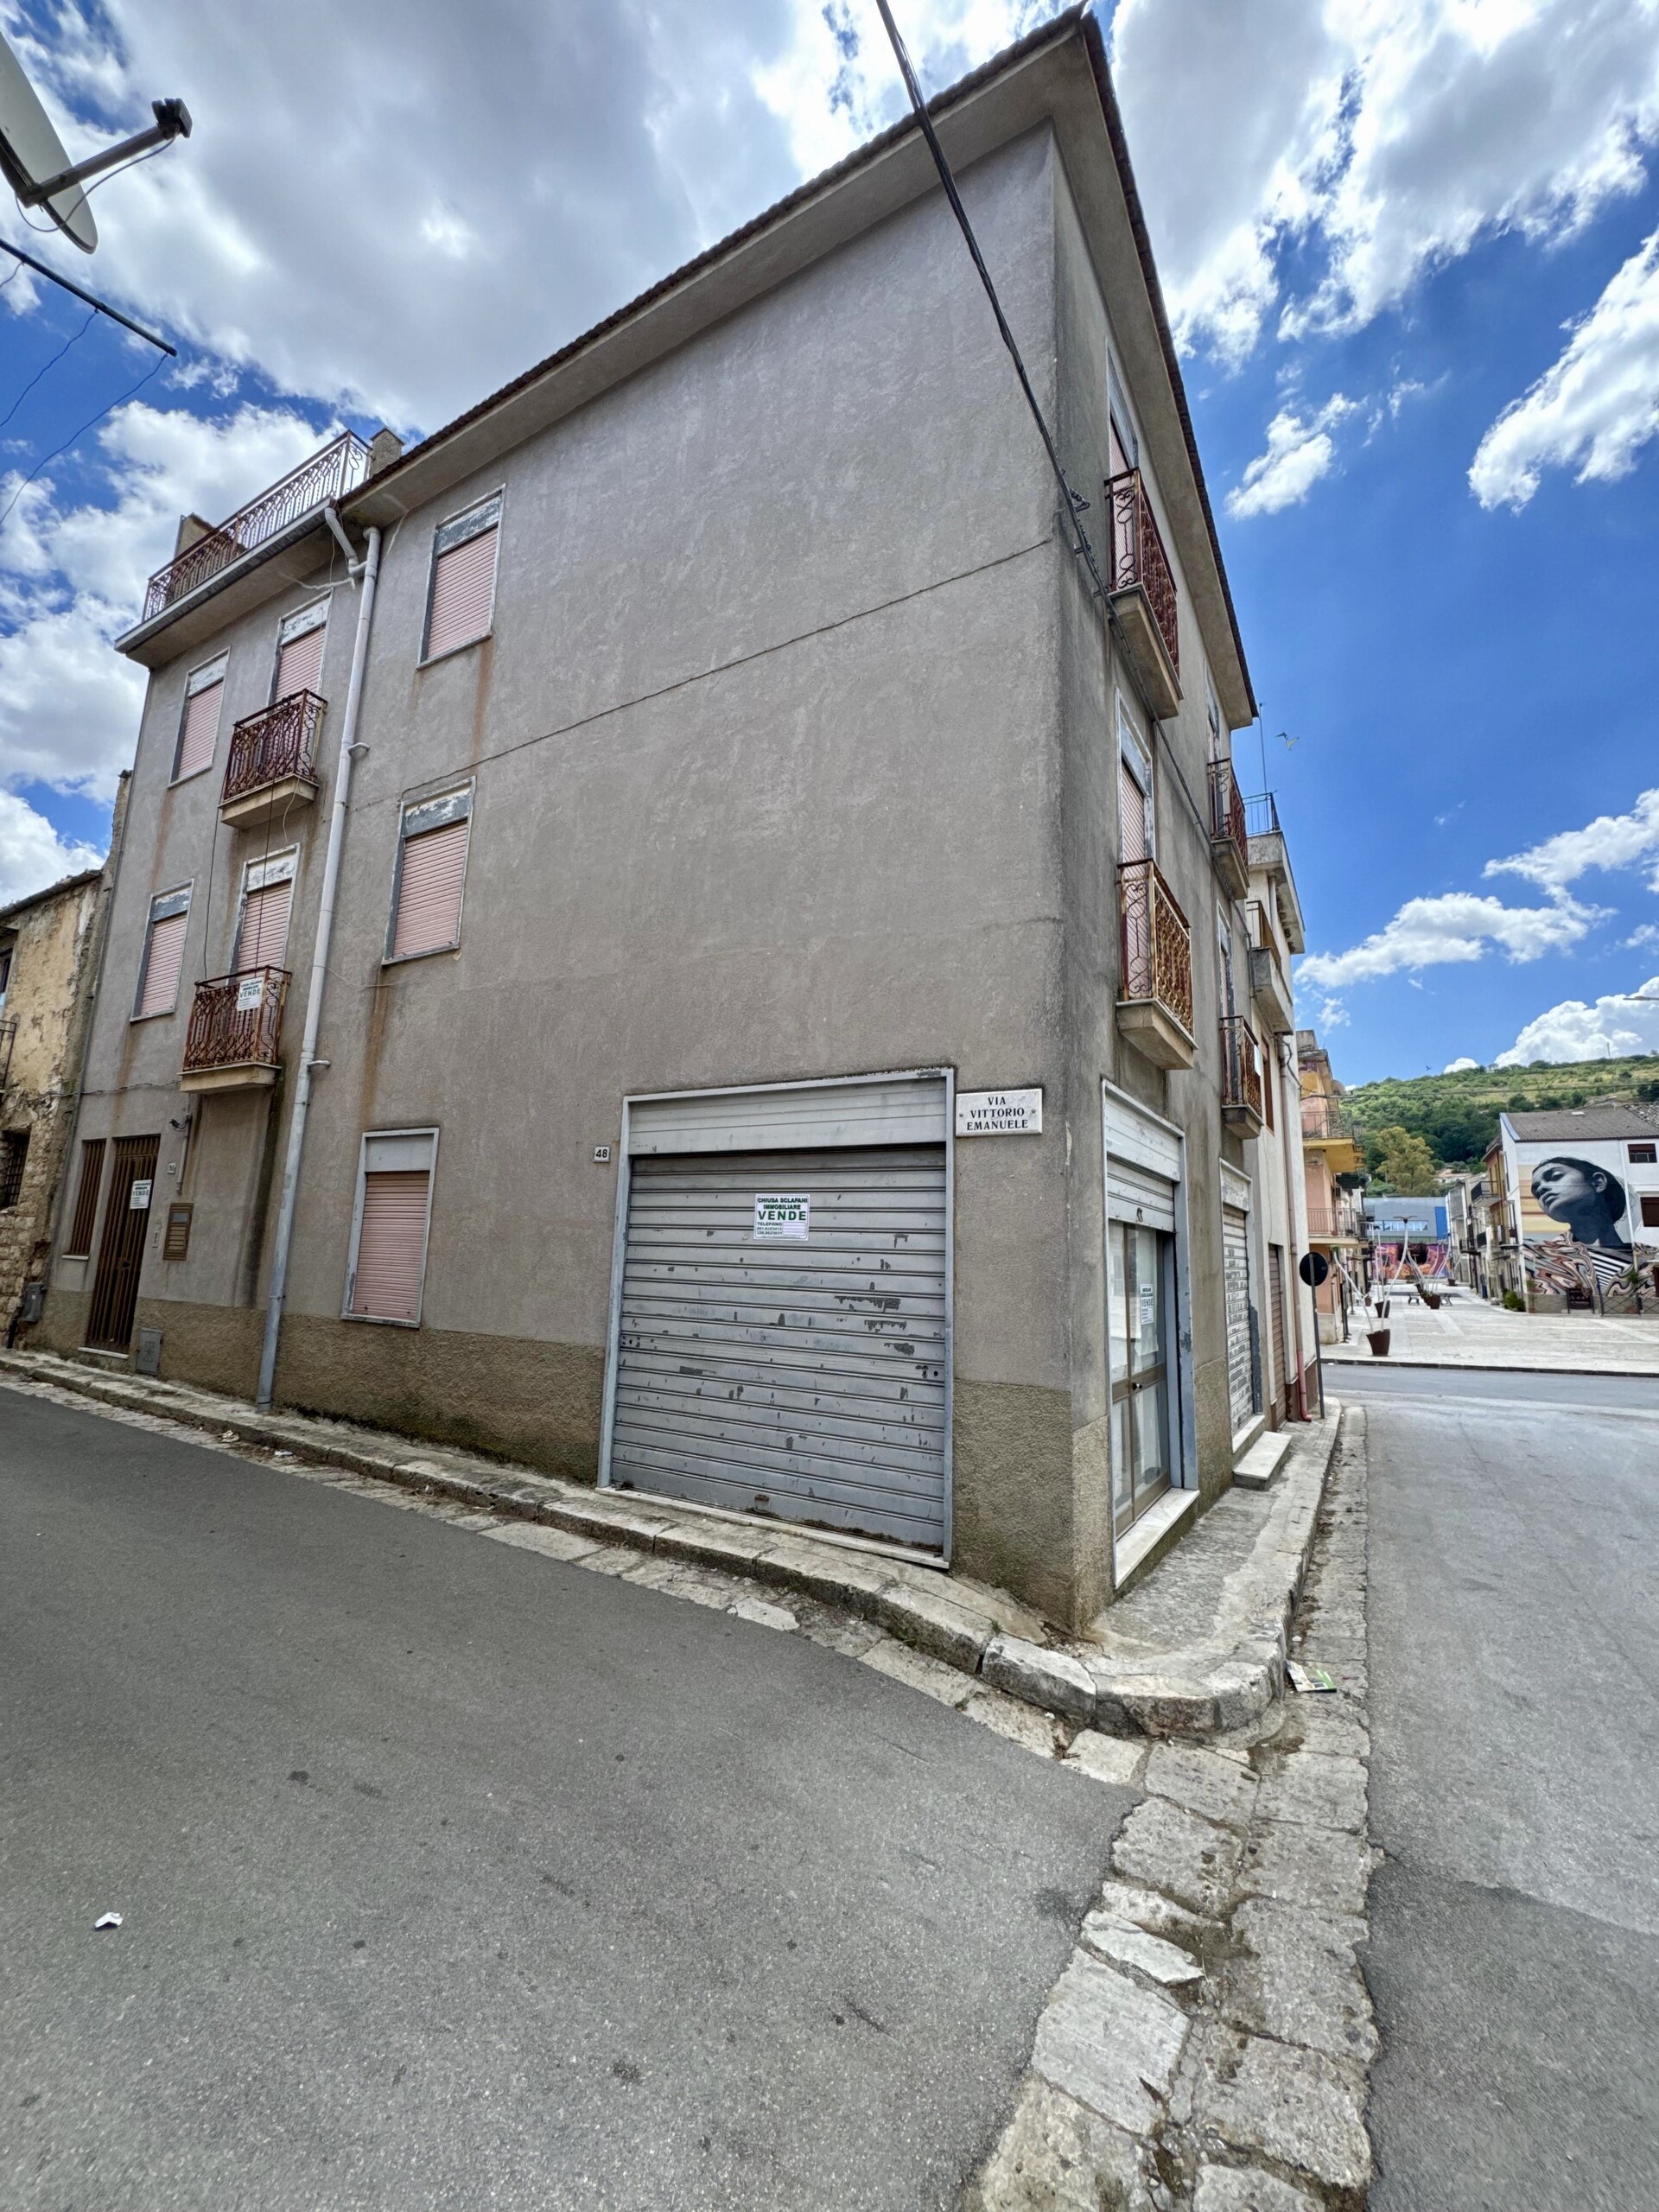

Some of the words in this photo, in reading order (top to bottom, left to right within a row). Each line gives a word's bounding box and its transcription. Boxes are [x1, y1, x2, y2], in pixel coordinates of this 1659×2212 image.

[239, 988, 261, 998] VENDE
[988, 1096, 1006, 1106] VIA
[969, 1107, 1025, 1118] VITTORIO
[967, 1119, 1028, 1130] EMANUELE
[596, 1148, 607, 1158] 48
[758, 1211, 806, 1221] VENDE
